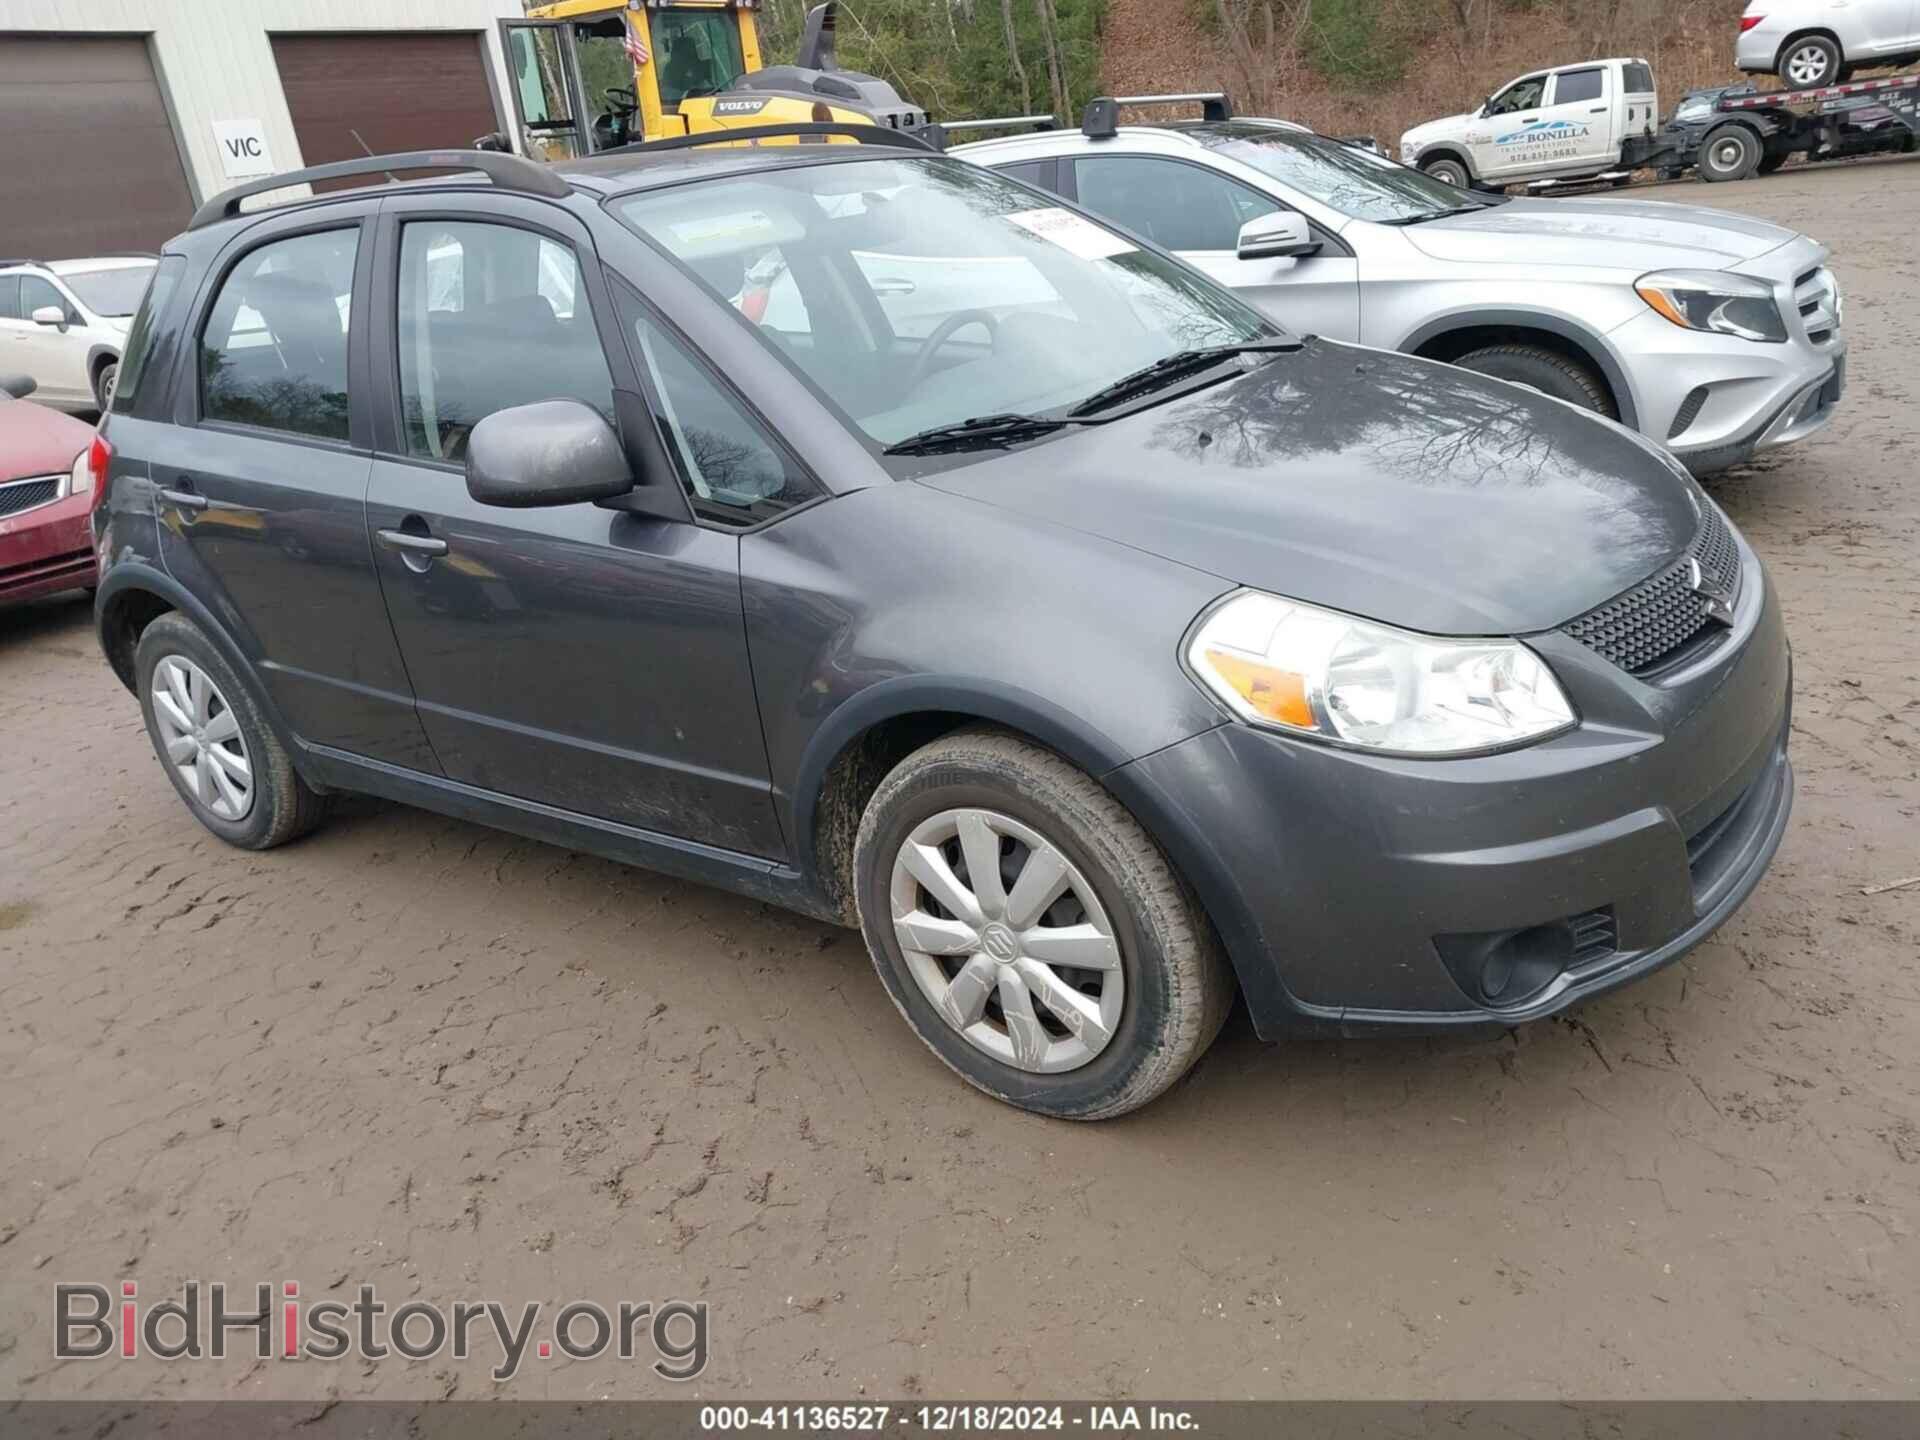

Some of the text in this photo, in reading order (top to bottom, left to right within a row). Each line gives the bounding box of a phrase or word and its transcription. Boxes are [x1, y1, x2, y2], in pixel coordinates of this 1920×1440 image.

[720, 101, 763, 111] VOLVO
[1527, 126, 1590, 143] BONILLA
[225, 136, 262, 158] VIC
